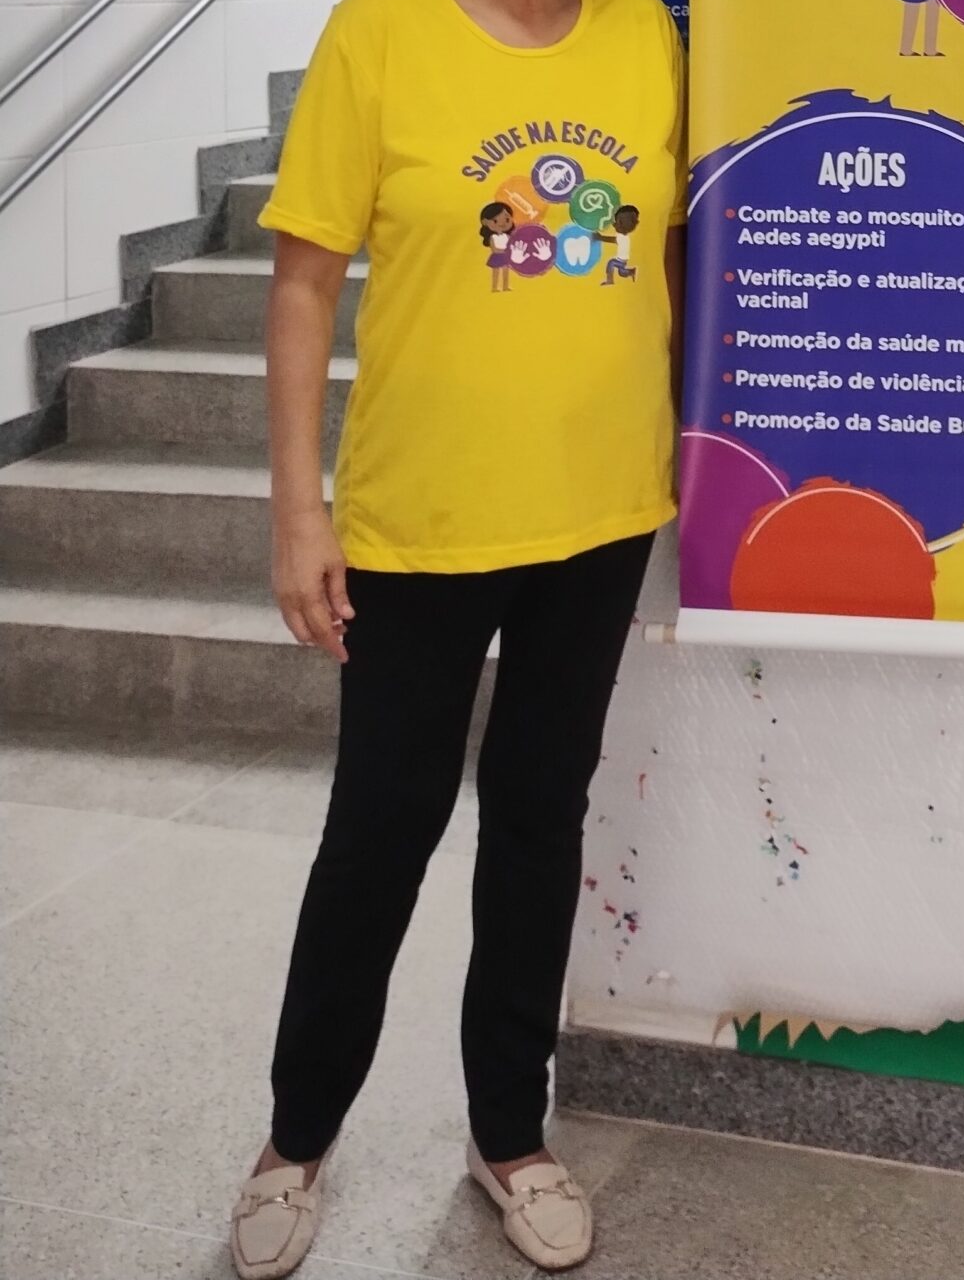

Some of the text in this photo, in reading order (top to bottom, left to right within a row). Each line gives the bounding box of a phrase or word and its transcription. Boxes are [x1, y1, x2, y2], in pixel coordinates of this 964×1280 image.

[461, 121, 638, 182] SAÚDE NA ESCOLA
[818, 146, 906, 193] AÇÕES
[738, 206, 831, 224] Combate
[836, 209, 862, 224] ao
[738, 228, 885, 250] Aedes aegypti
[737, 269, 852, 289] Verificação
[857, 276, 870, 288] e
[737, 292, 808, 309] vacinal
[736, 331, 841, 352] Promoção
[846, 333, 873, 351] da
[878, 334, 940, 352] saúde
[735, 370, 843, 391] Prevenção
[848, 373, 875, 390] de
[735, 411, 840, 432] Promoção
[845, 413, 872, 431] da
[877, 415, 942, 434] Saúde
